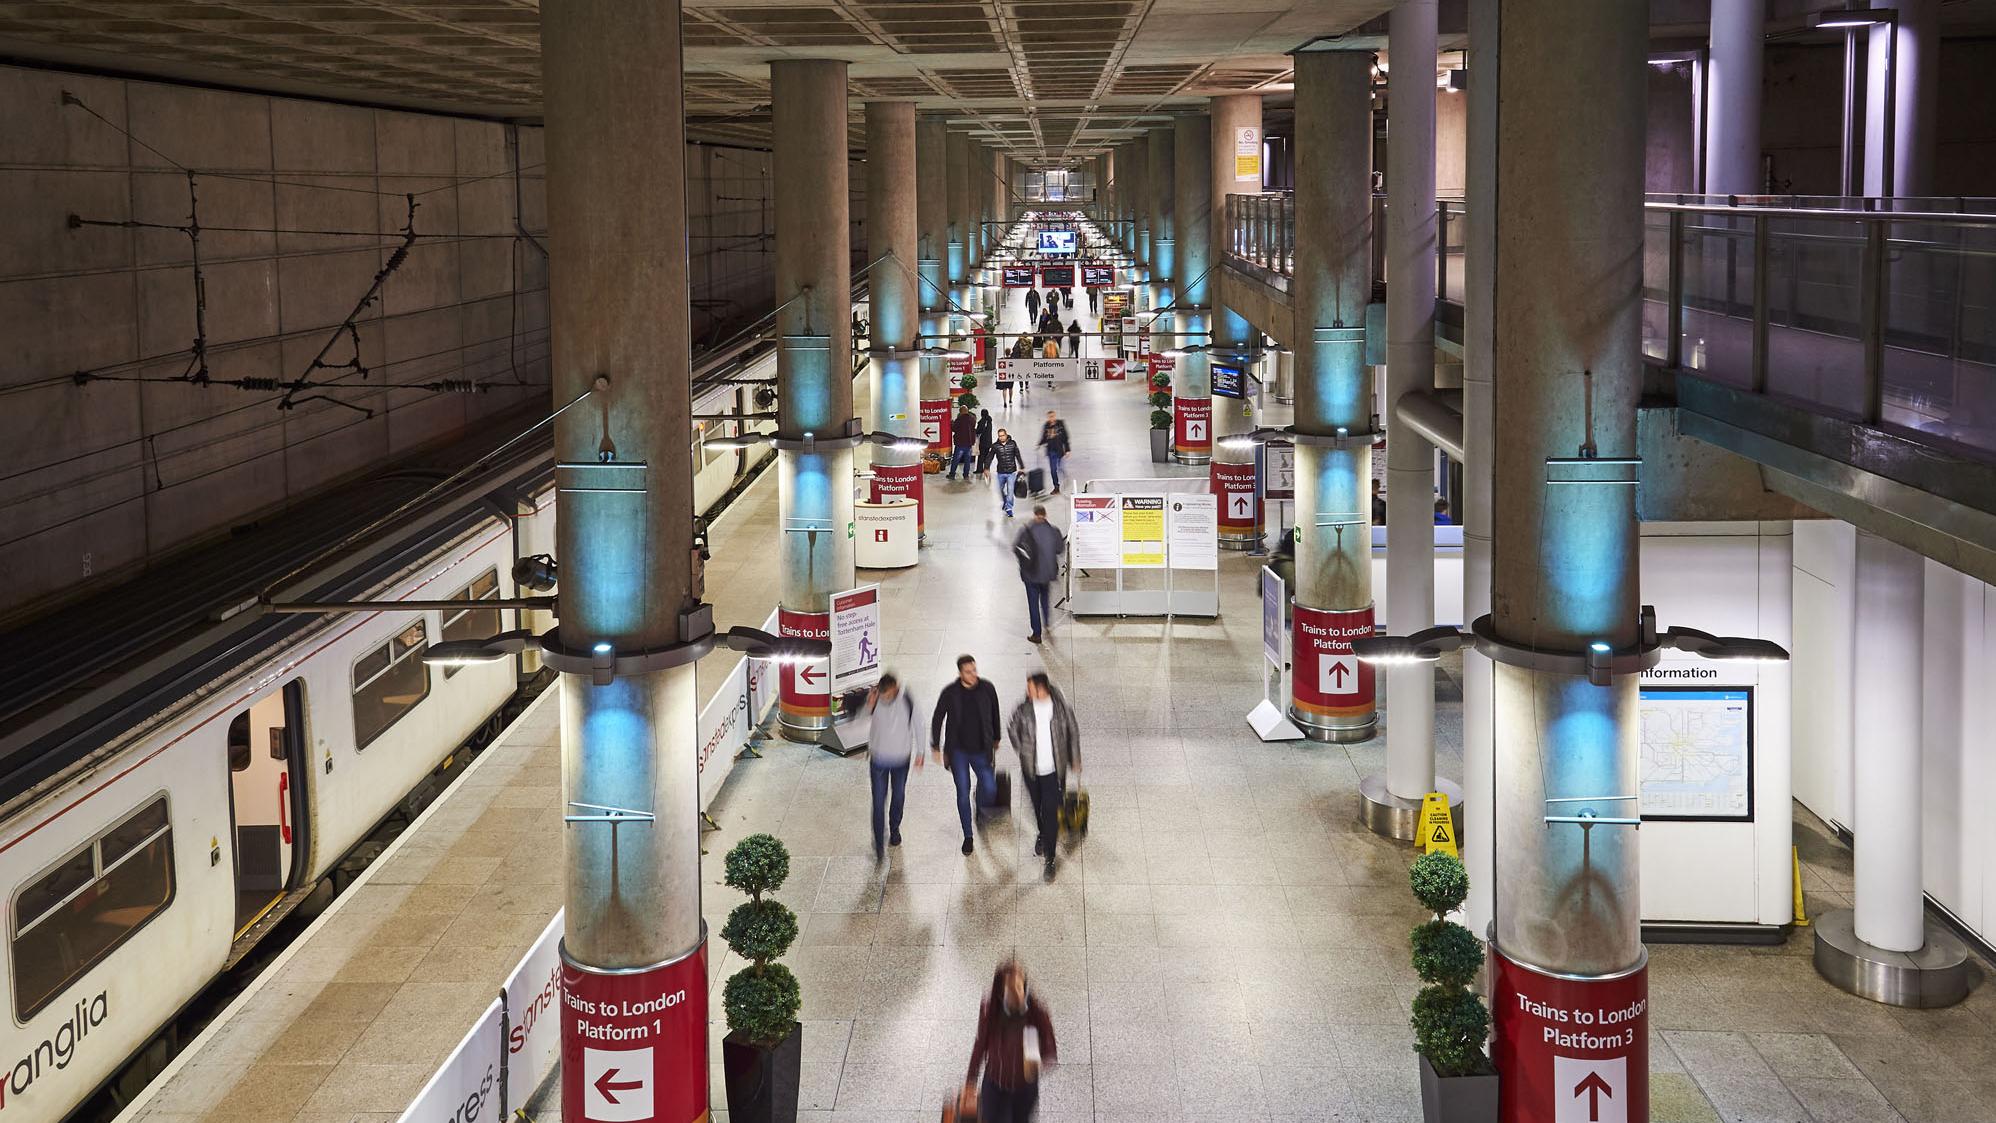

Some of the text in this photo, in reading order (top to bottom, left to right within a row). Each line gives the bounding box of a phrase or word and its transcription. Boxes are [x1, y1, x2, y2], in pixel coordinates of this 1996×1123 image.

[782, 624, 801, 637] Trains
[803, 628, 813, 637] to
[838, 621, 875, 636] Tottenham Hale
[1301, 622, 1372, 636] Trains to London
[563, 986, 685, 1017] Trains to London
[1517, 992, 1646, 1024] Trains to London
[577, 1019, 662, 1040] Platform 1
[1543, 1027, 1633, 1049] Platform 3
